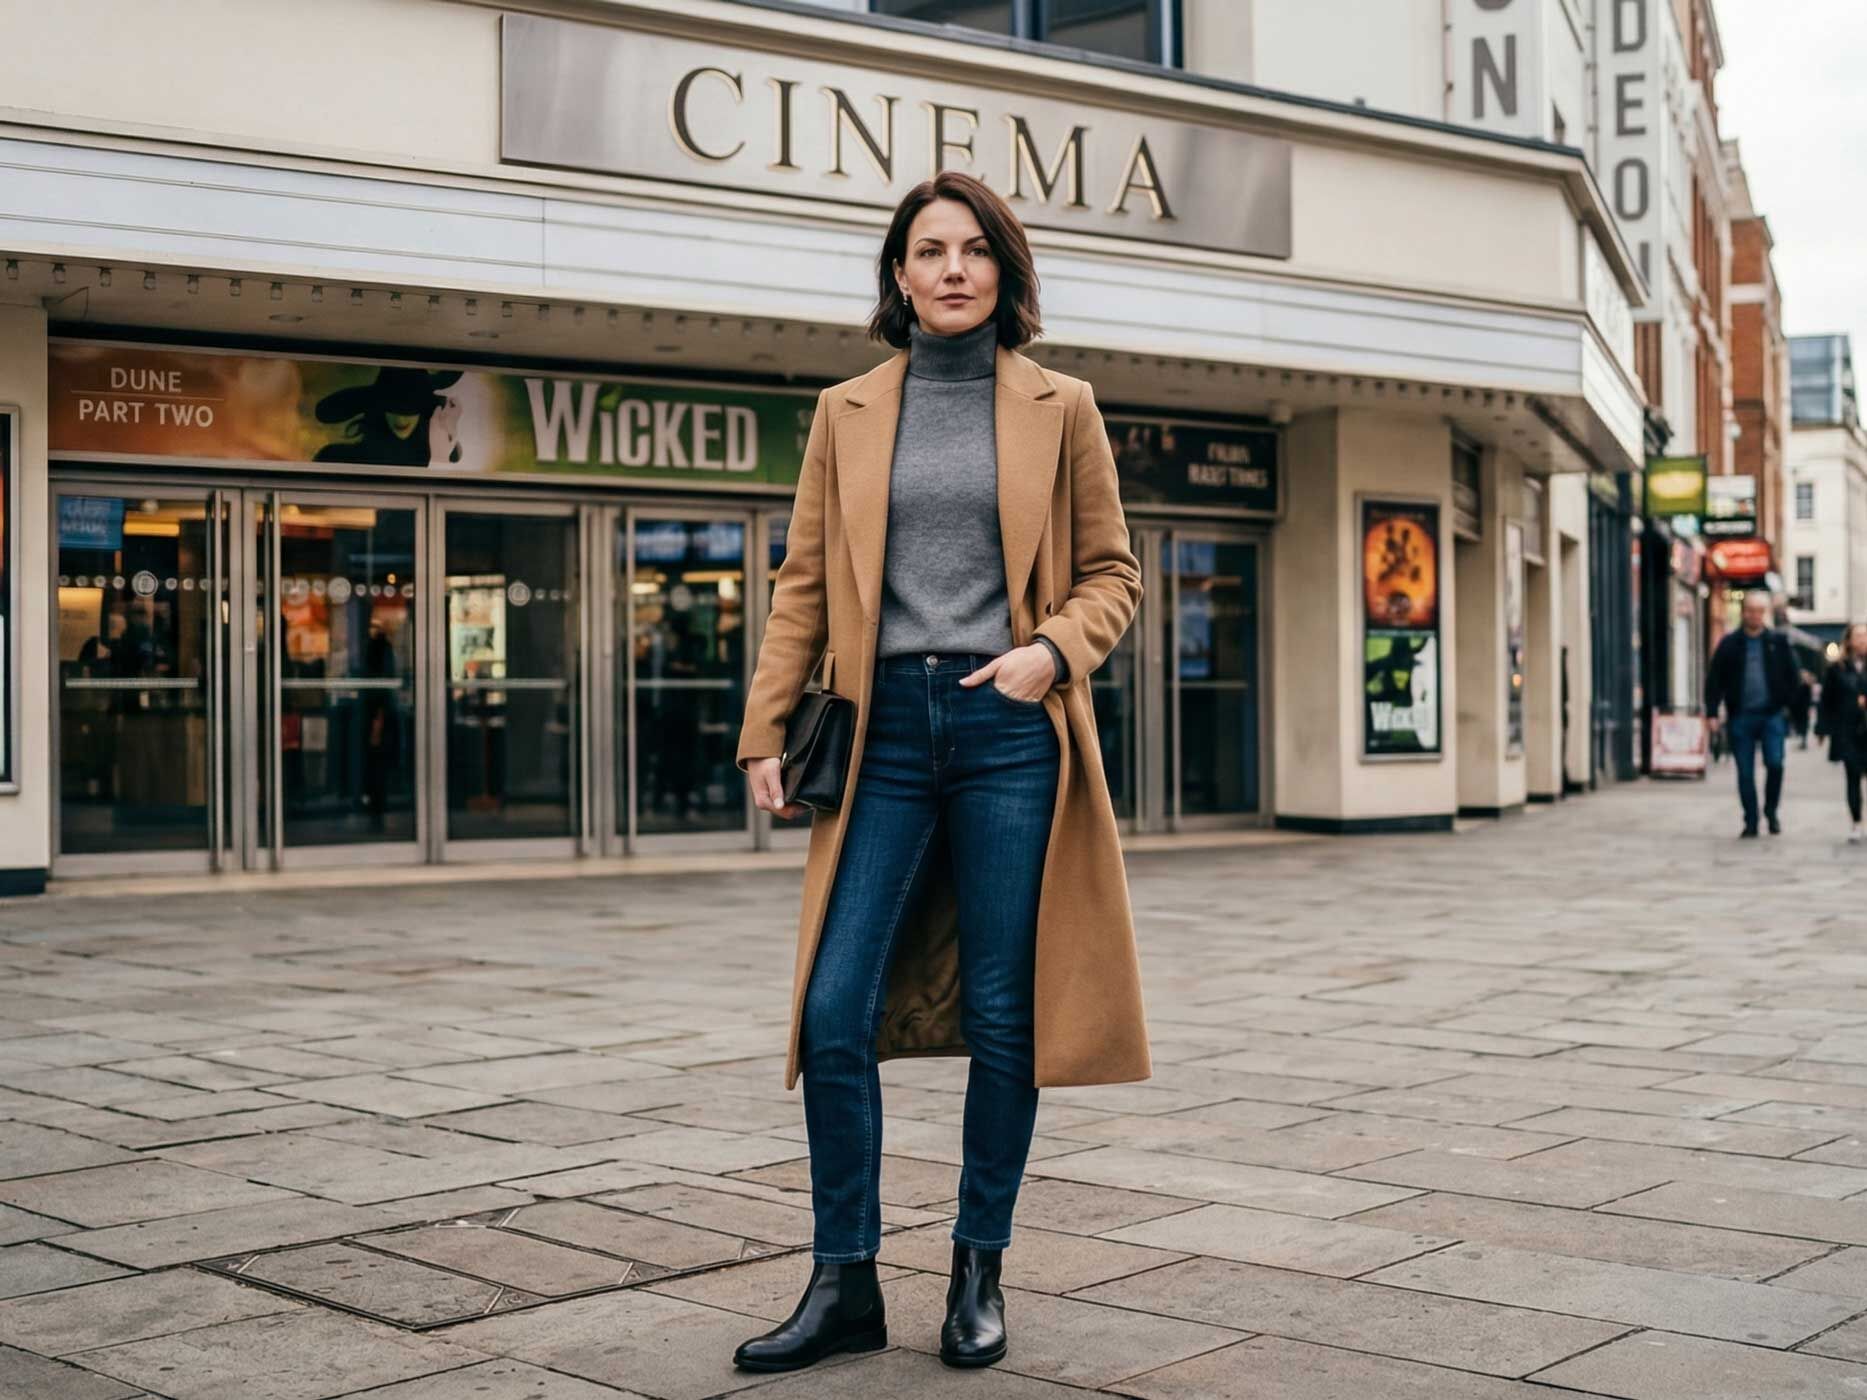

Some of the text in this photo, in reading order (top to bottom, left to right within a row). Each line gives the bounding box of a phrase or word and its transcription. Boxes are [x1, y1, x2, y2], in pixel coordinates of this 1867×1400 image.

[668, 66, 1176, 221] CINEMA
[110, 367, 182, 393] DUNE
[79, 399, 214, 428] PART TWO
